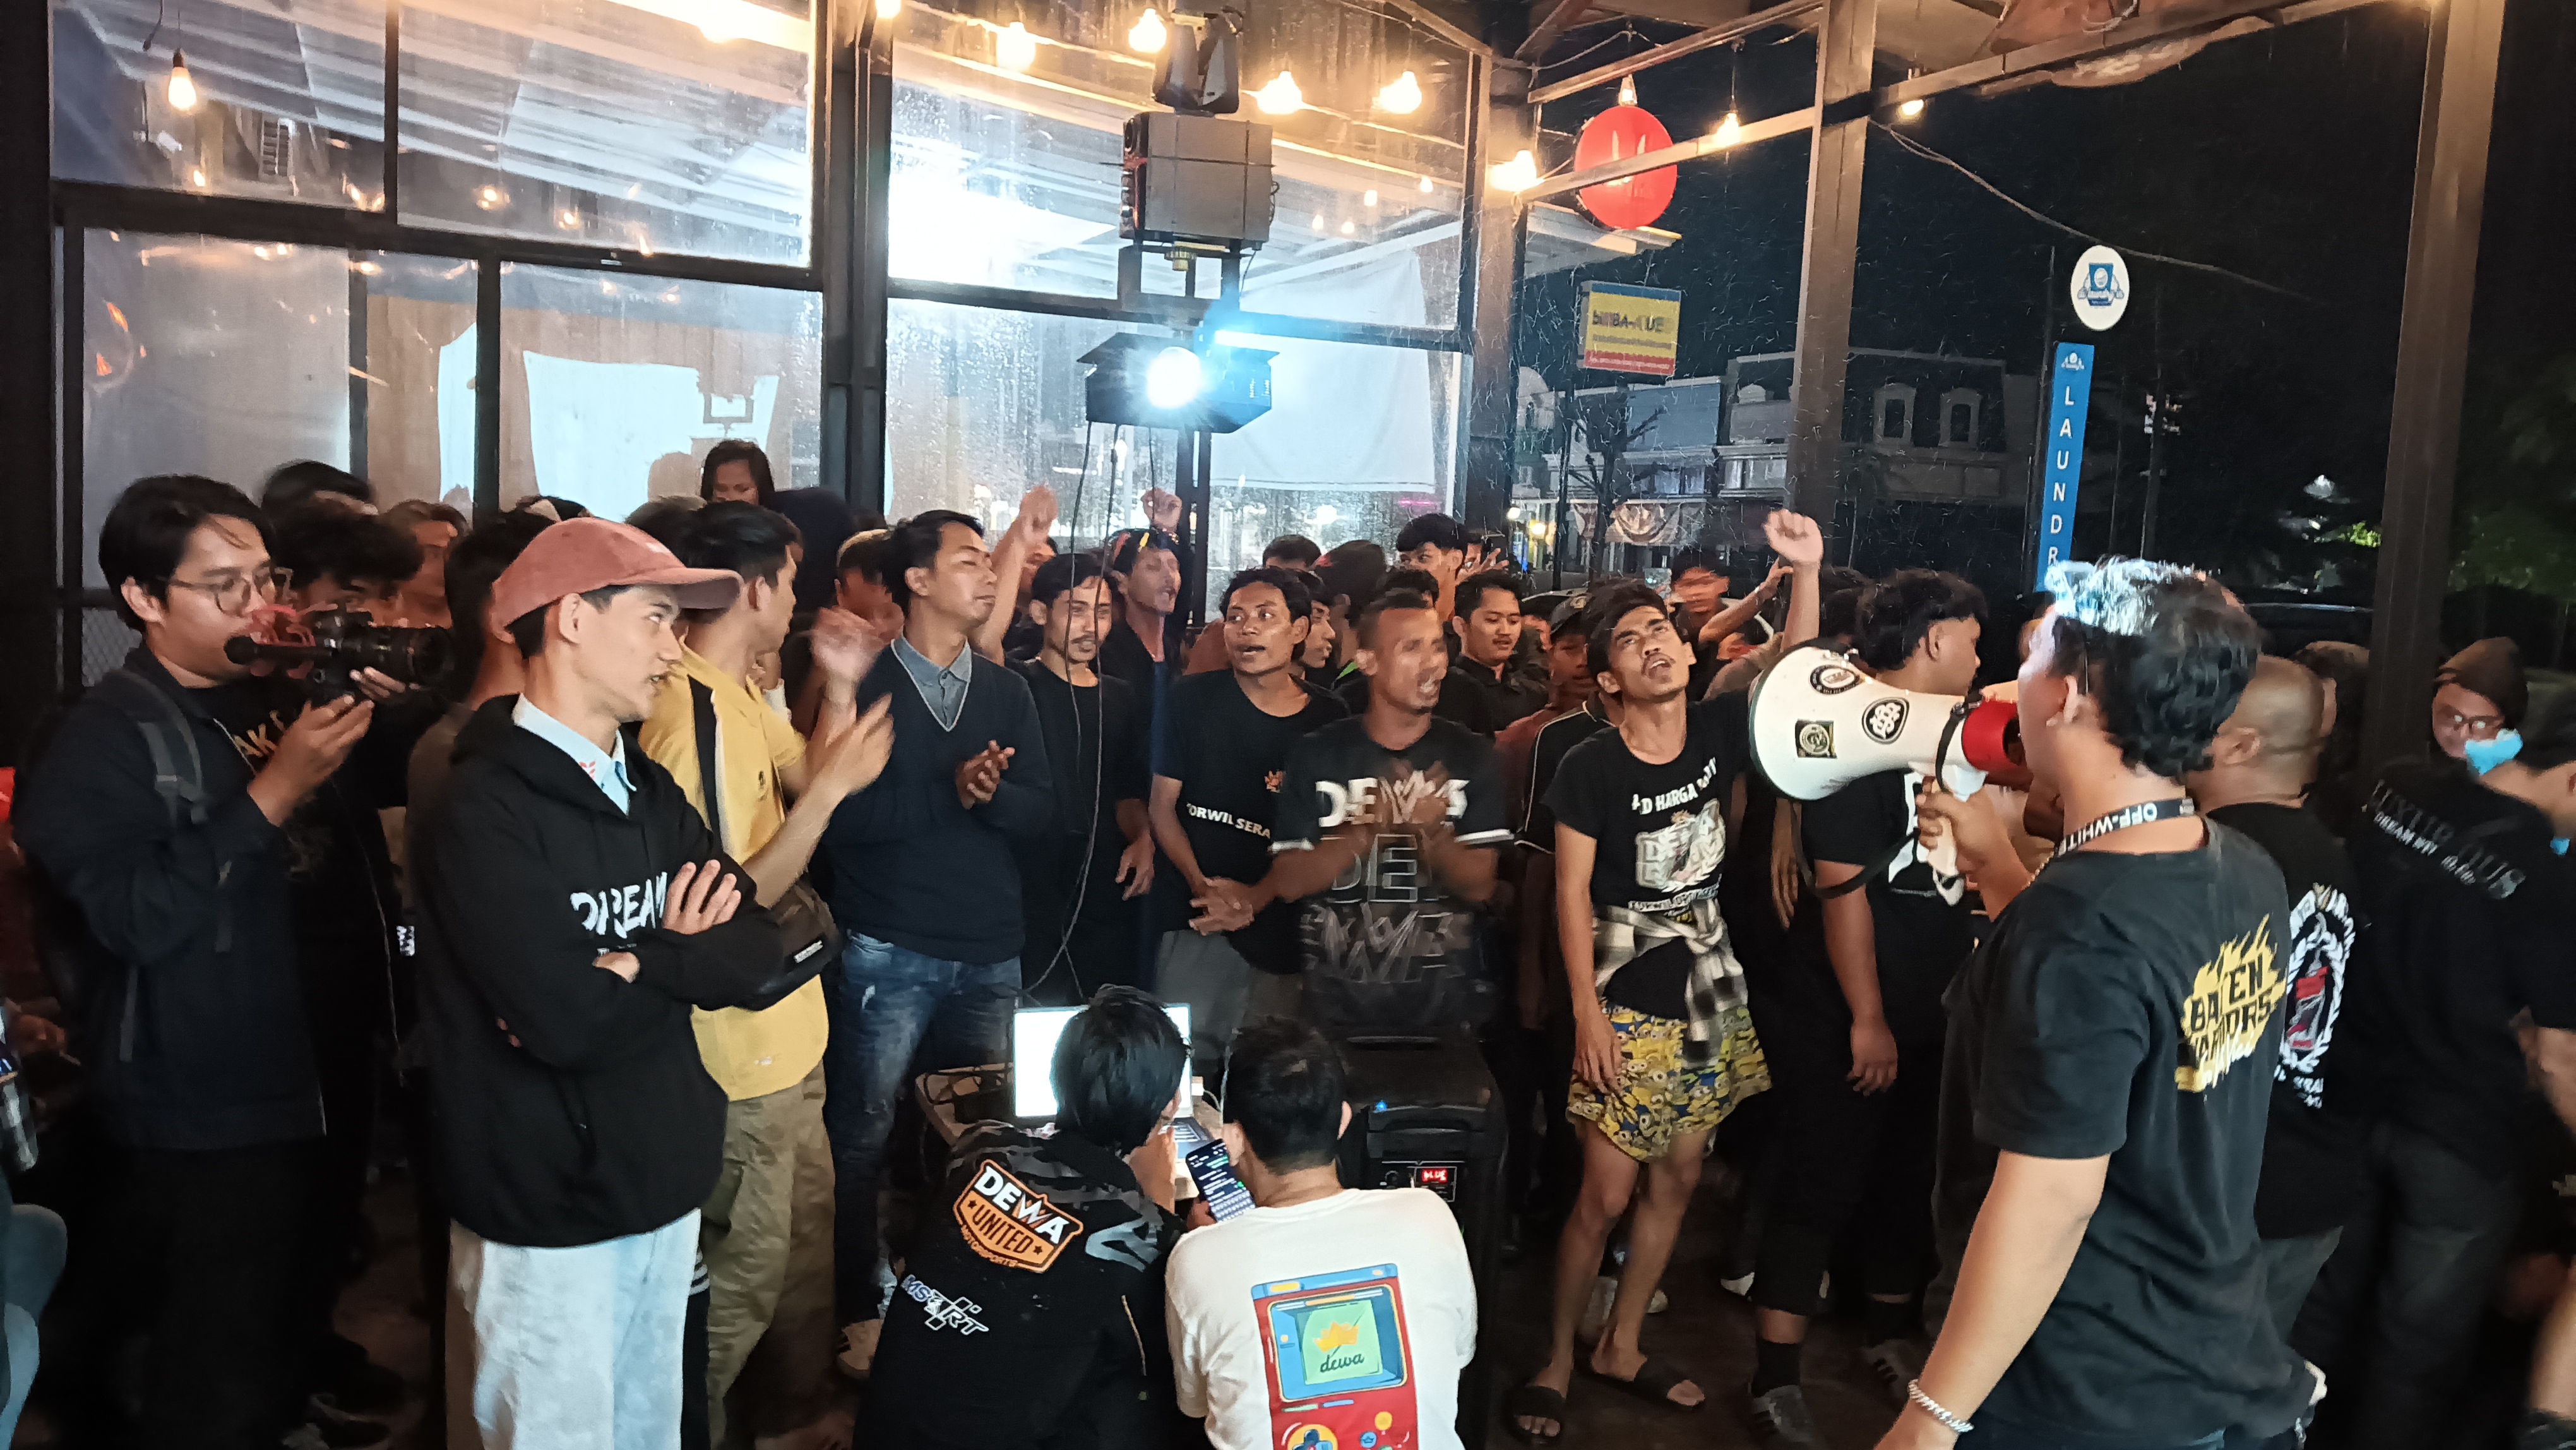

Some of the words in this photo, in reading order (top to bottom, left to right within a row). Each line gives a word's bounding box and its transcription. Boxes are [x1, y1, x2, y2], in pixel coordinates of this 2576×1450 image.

[2048, 385, 2075, 566] LAUNDR
[1655, 782, 1698, 812] HARGA
[1235, 817, 1271, 839] SERA
[974, 1165, 1070, 1245] DEWA
[972, 1204, 1034, 1254] UNITED
[1320, 1354, 1365, 1373] dewa
